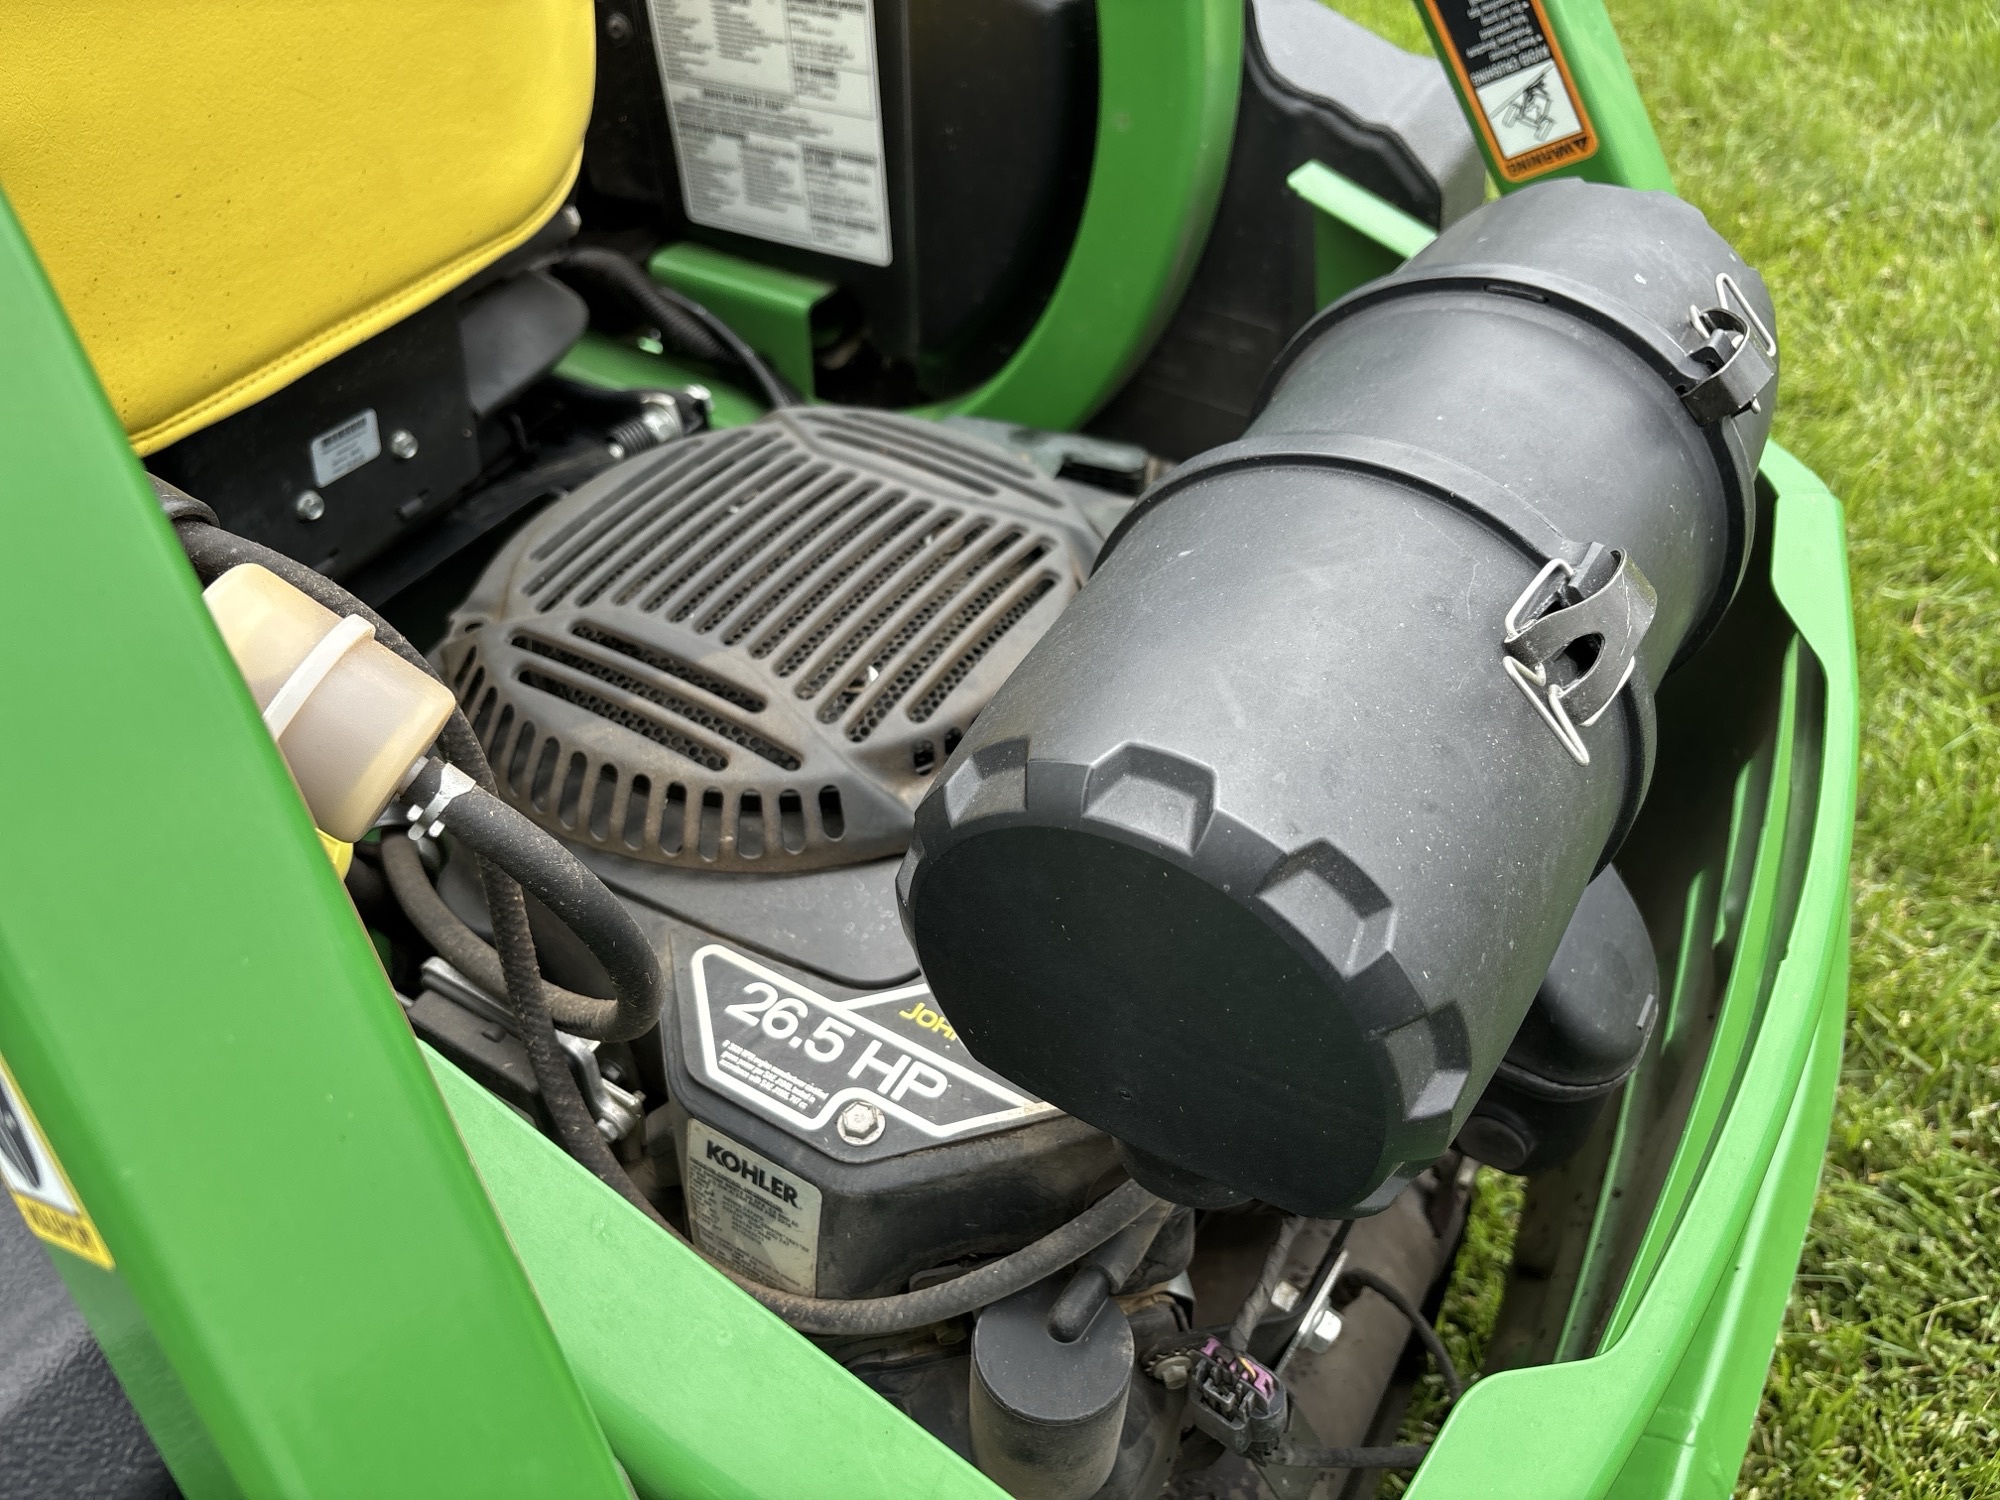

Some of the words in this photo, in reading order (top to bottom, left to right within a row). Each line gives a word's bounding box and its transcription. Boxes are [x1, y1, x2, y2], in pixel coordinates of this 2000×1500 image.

[1470, 56, 1522, 87] CRUSHING
[1518, 44, 1550, 67] AVOID
[1506, 144, 1574, 174] WARNING
[899, 1001, 957, 1041] JOH
[724, 981, 856, 1063] 26.5
[847, 1038, 949, 1101] HP
[706, 1139, 799, 1208] KOHLER
